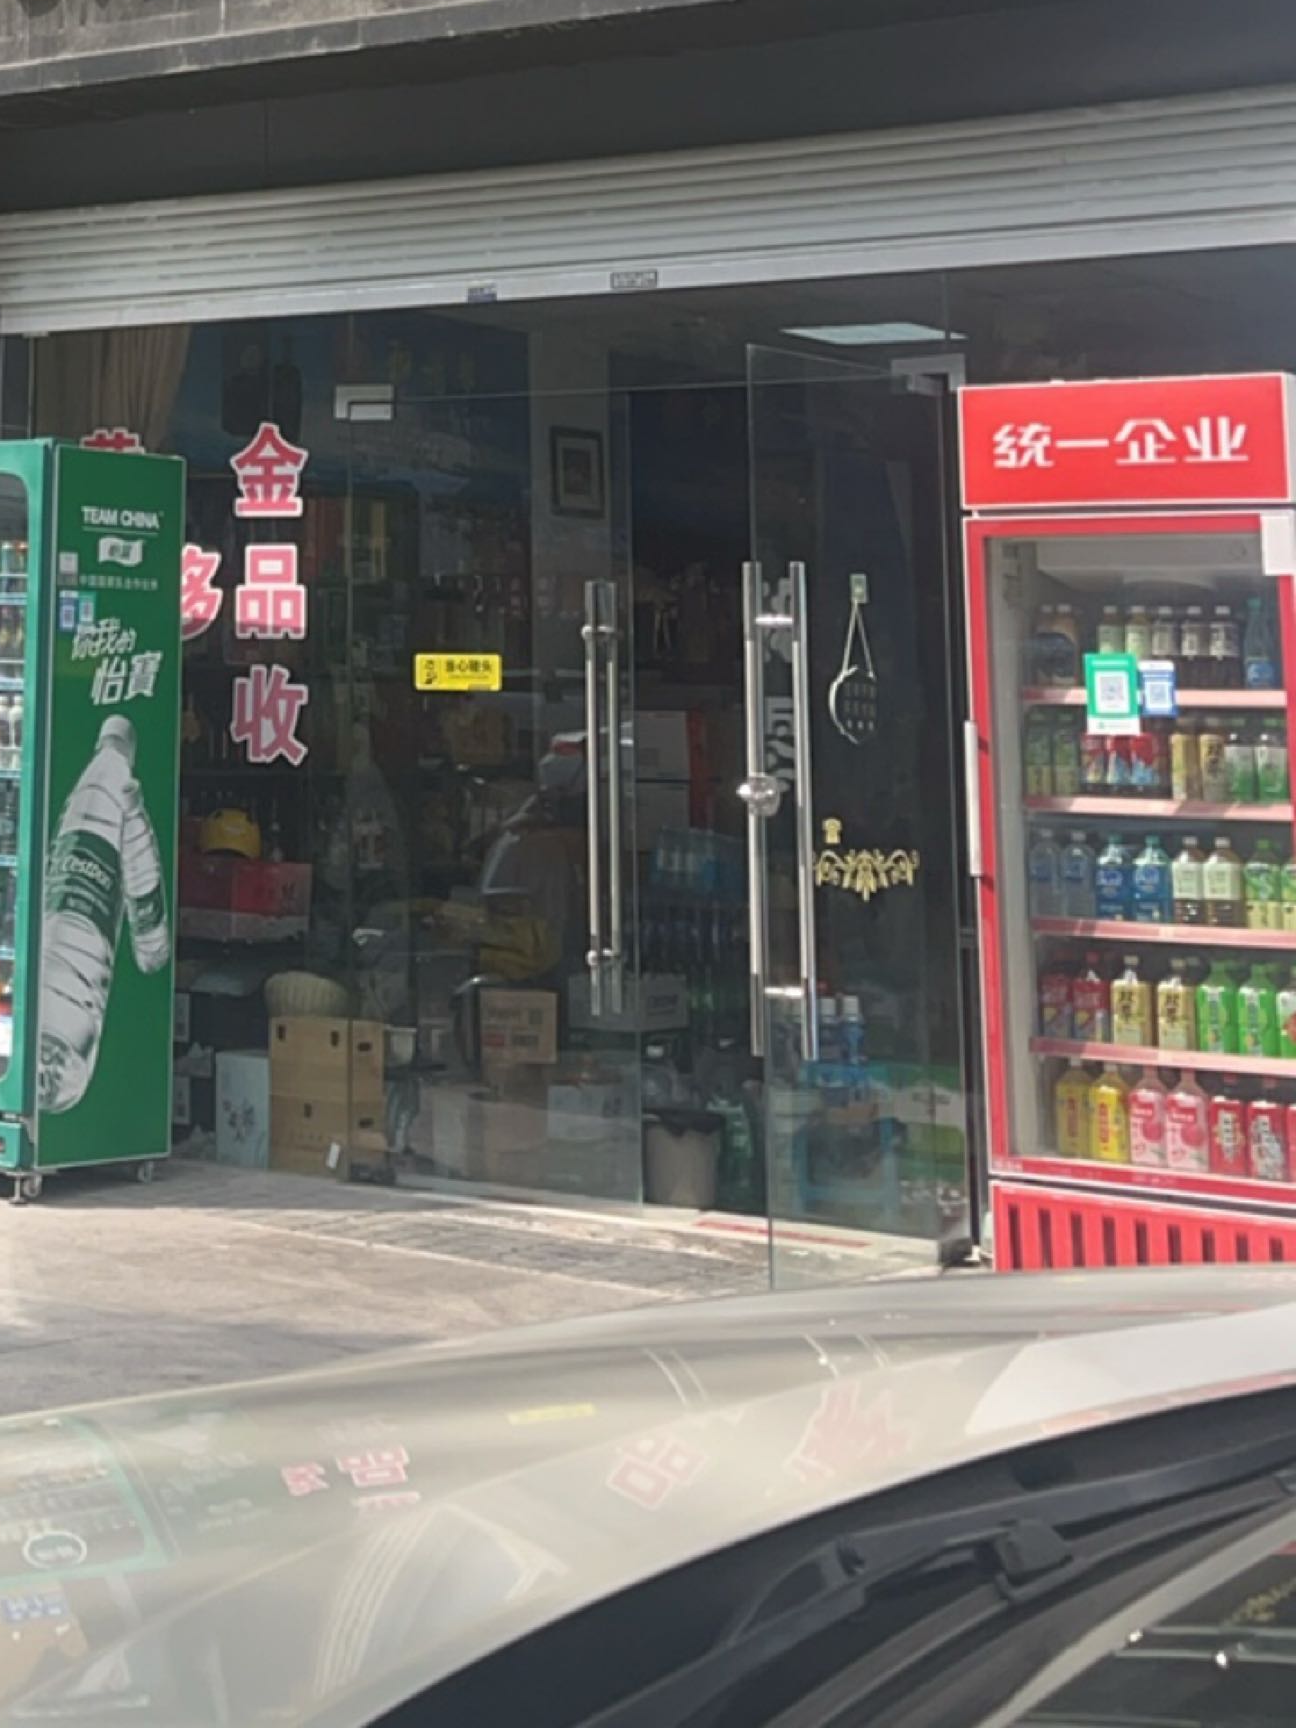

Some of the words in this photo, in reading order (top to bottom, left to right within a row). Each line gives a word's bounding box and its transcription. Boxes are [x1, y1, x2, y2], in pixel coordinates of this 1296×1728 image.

[992, 416, 1249, 469] 统一企业
[81, 506, 118, 527] TEAM
[120, 508, 160, 529] CHINA
